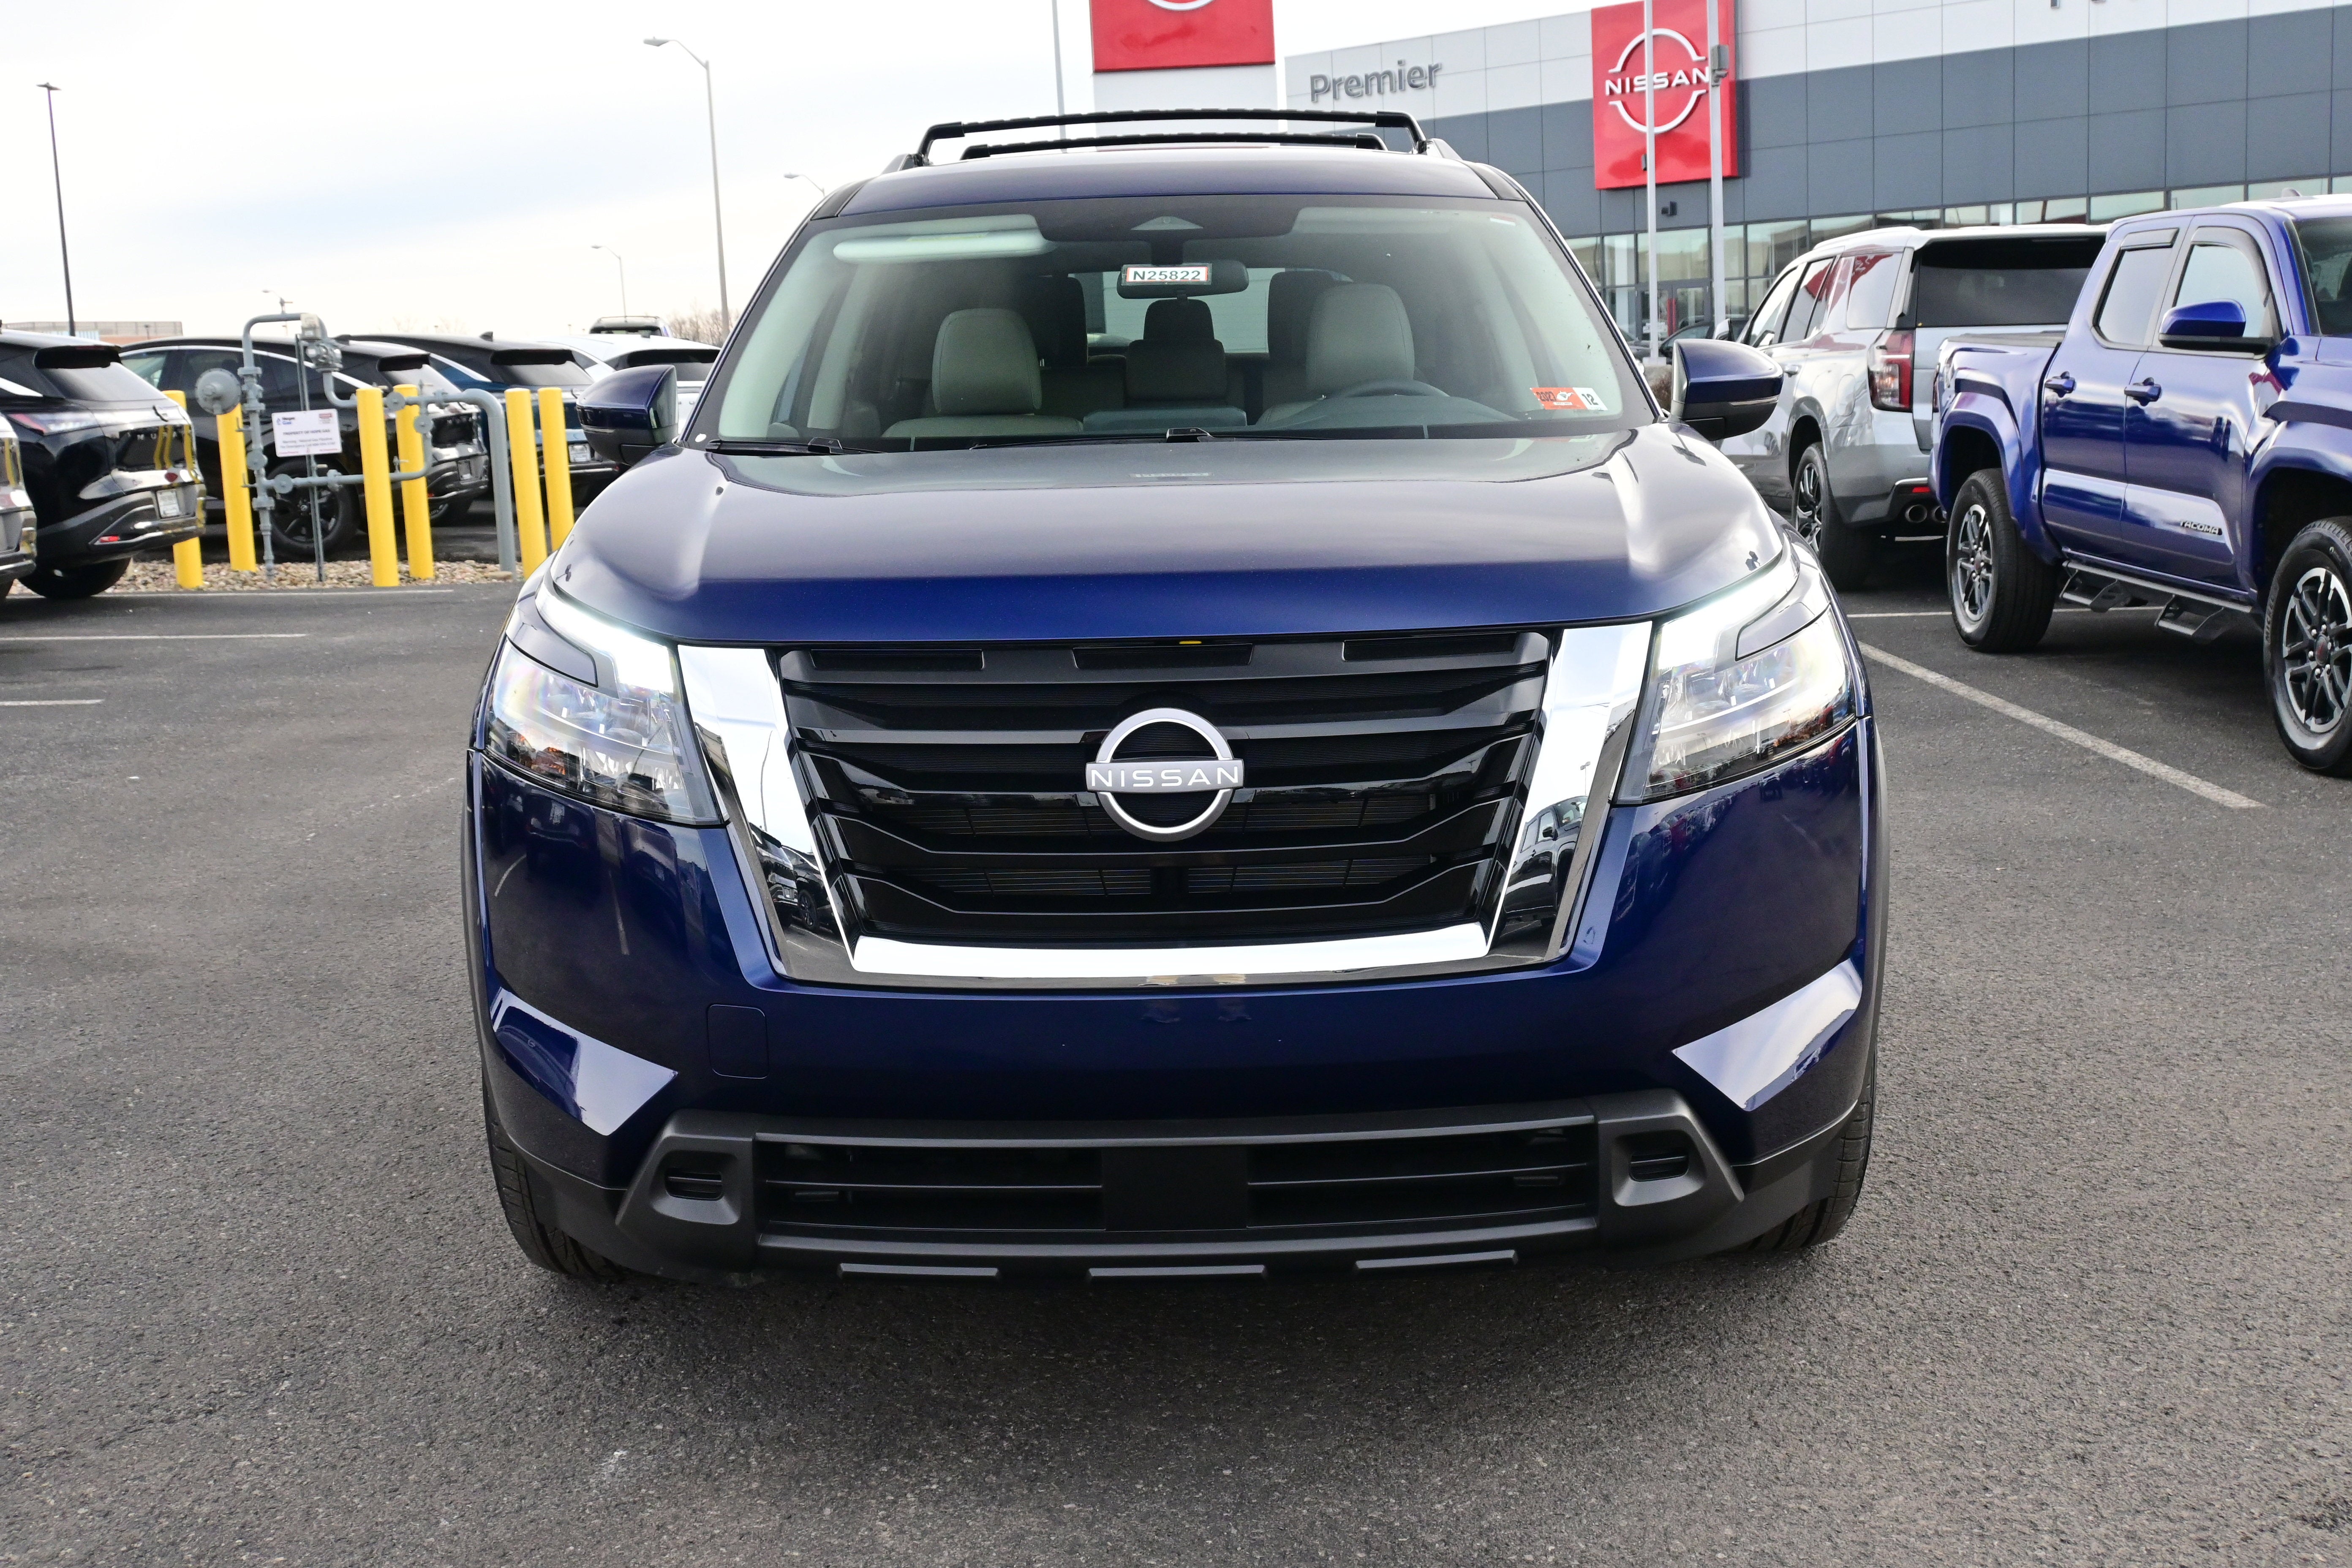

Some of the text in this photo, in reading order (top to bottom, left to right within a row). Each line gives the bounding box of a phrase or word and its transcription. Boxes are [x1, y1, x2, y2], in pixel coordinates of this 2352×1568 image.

[1310, 60, 1441, 102] Premier
[1605, 66, 1709, 96] NISSAN
[1133, 270, 1200, 280] N25822
[1536, 391, 1599, 405] 2027 12
[2180, 520, 2219, 535] TACOMA
[1091, 766, 1239, 787] NISSAN
